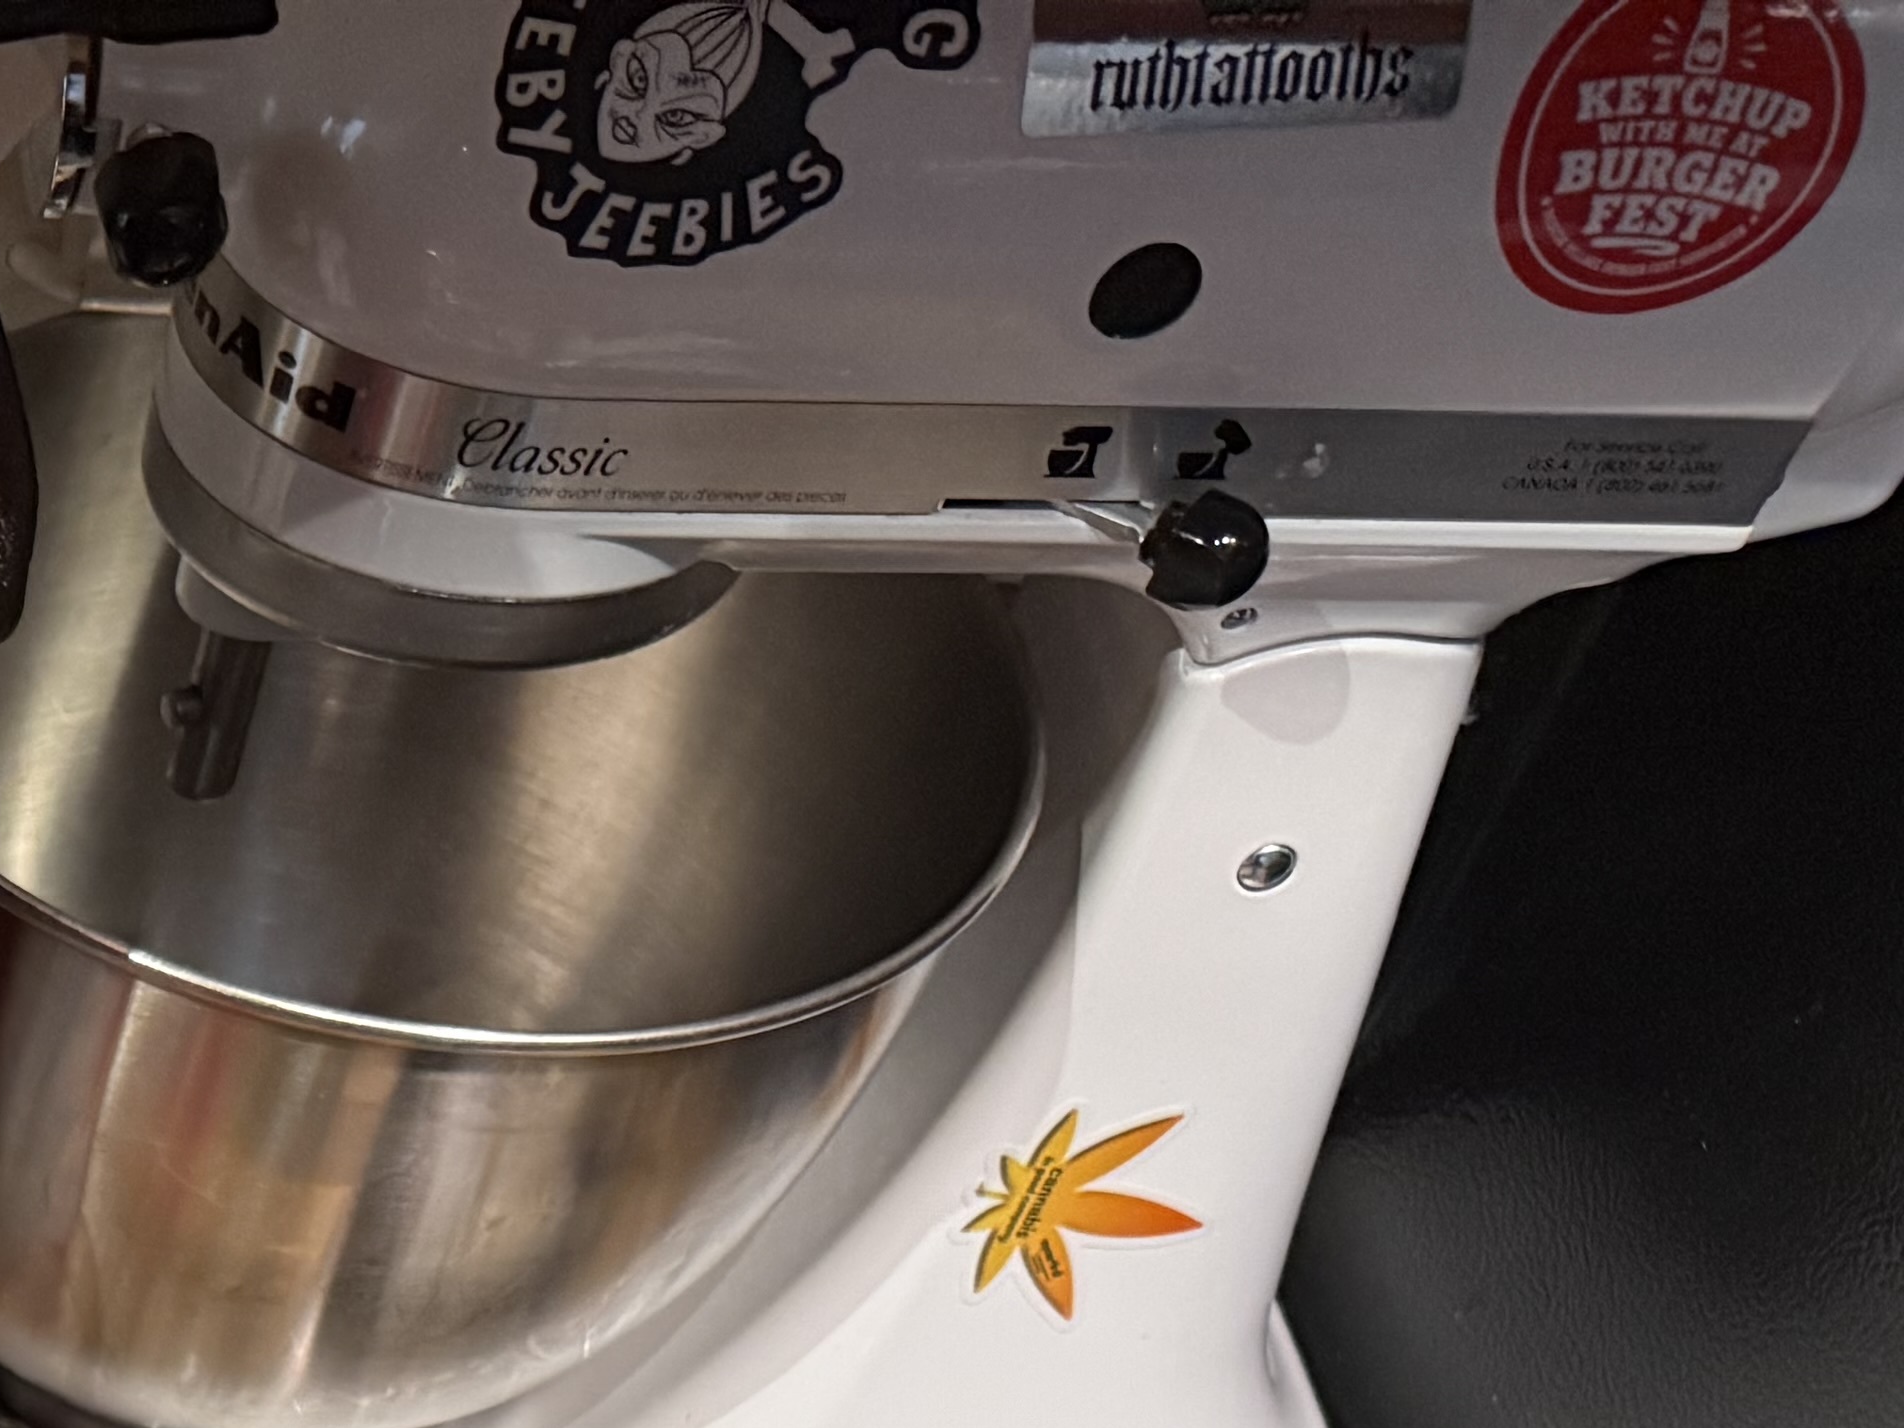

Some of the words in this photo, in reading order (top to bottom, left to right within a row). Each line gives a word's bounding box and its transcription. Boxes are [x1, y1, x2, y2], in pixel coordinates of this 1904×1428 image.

[1576, 74, 1812, 139] KETCHUP
[1598, 120, 1677, 145] WITH
[1683, 121, 1728, 149] ME
[1728, 129, 1771, 158] AT
[542, 149, 833, 256] JEEBIES
[1554, 146, 1780, 212] BURGER
[1582, 193, 1724, 242] FEST
[455, 417, 630, 478] Classic
